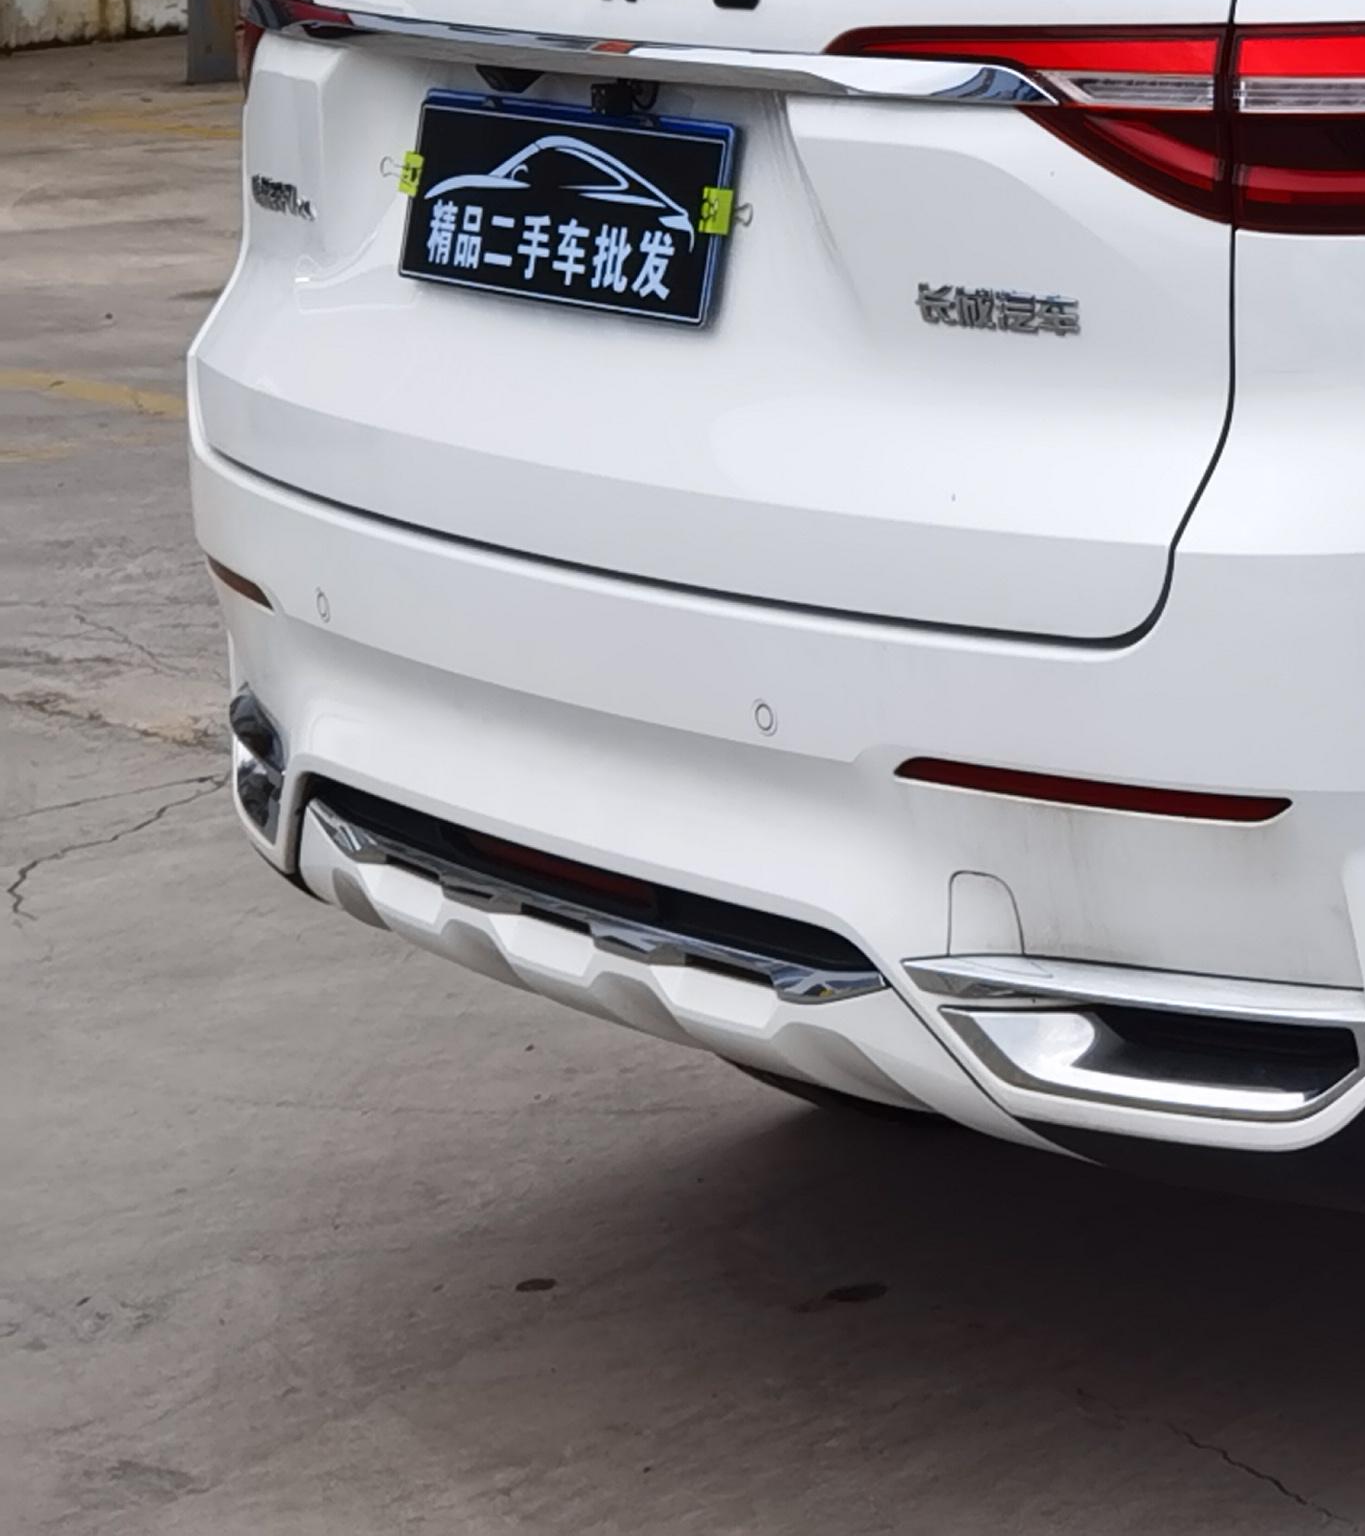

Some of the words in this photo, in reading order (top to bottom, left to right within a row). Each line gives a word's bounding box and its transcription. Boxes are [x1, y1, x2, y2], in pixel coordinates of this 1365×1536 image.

[427, 198, 676, 300] 精品二手车批发
